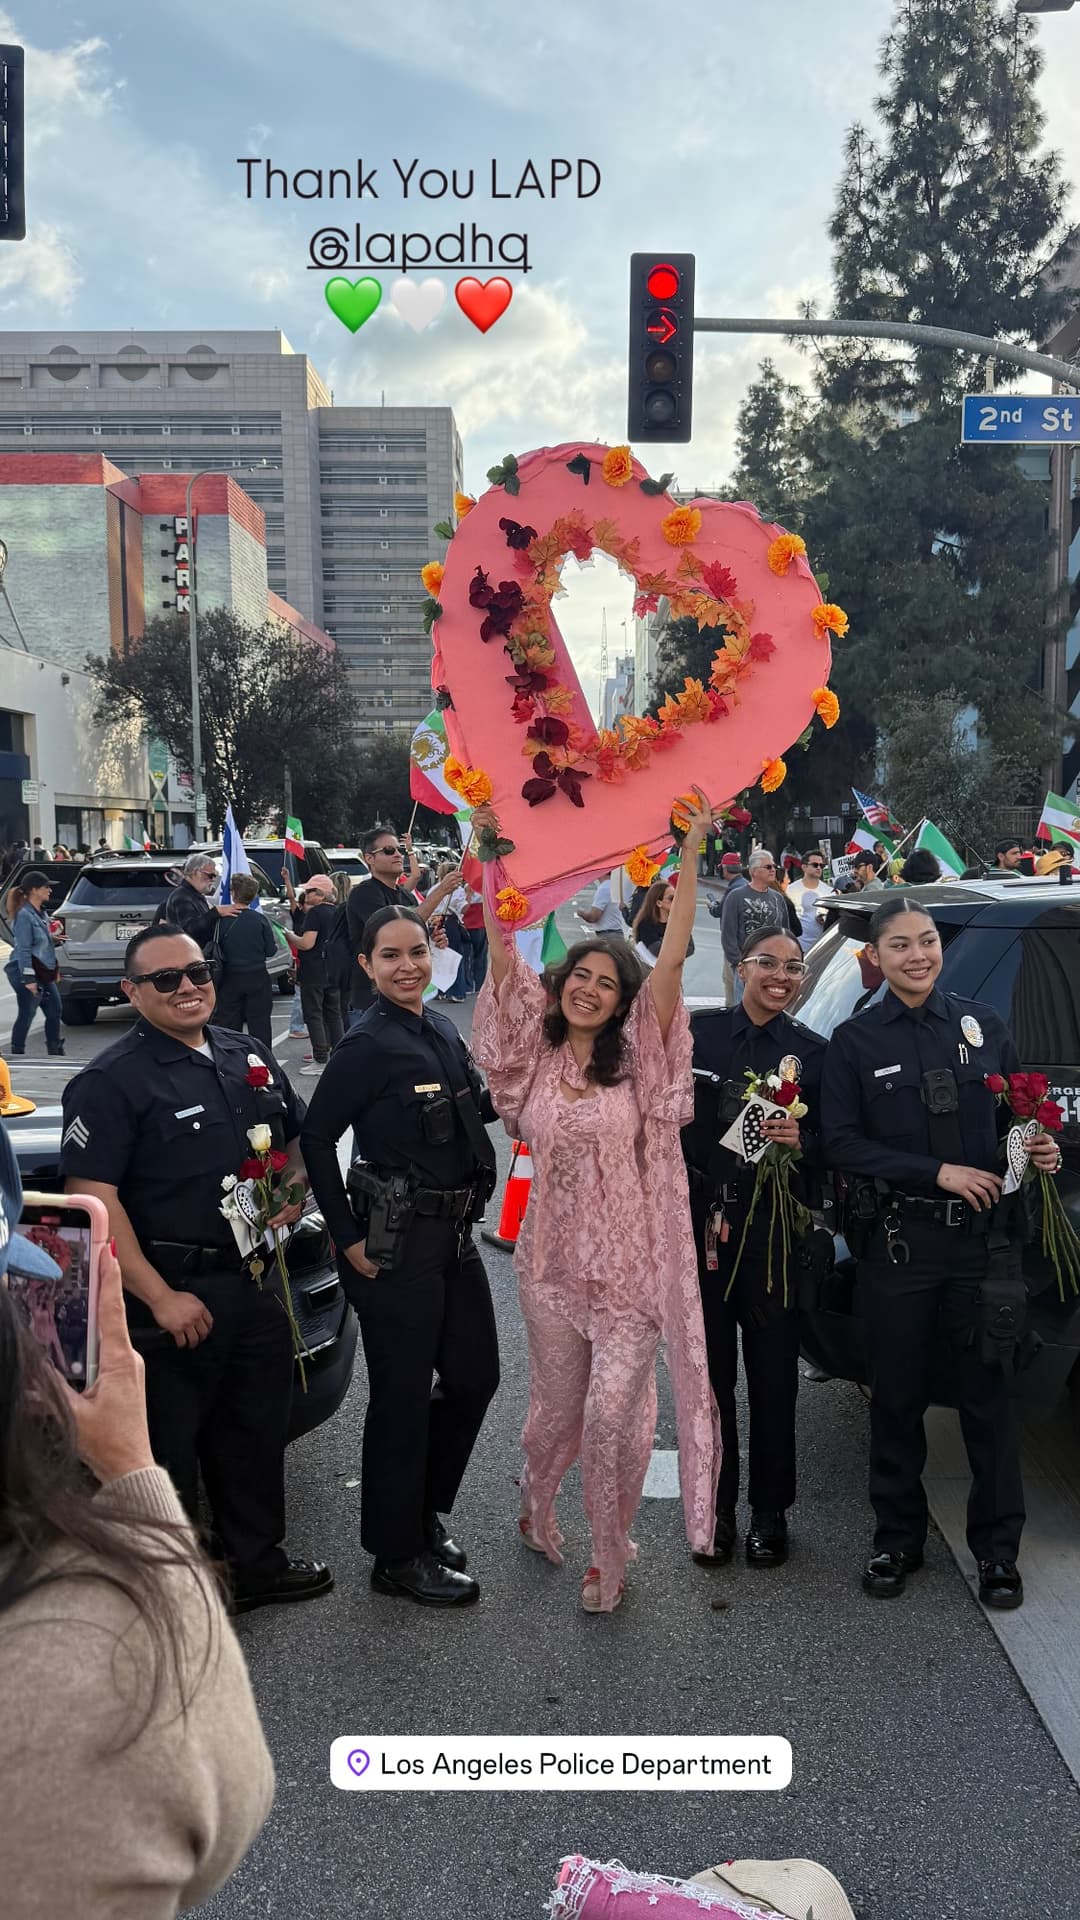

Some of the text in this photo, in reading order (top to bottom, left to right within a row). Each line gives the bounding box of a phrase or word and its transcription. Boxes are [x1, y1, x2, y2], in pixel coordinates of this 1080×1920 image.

[979, 406, 1073, 431] 2nd St
[175, 517, 190, 613] PARK
